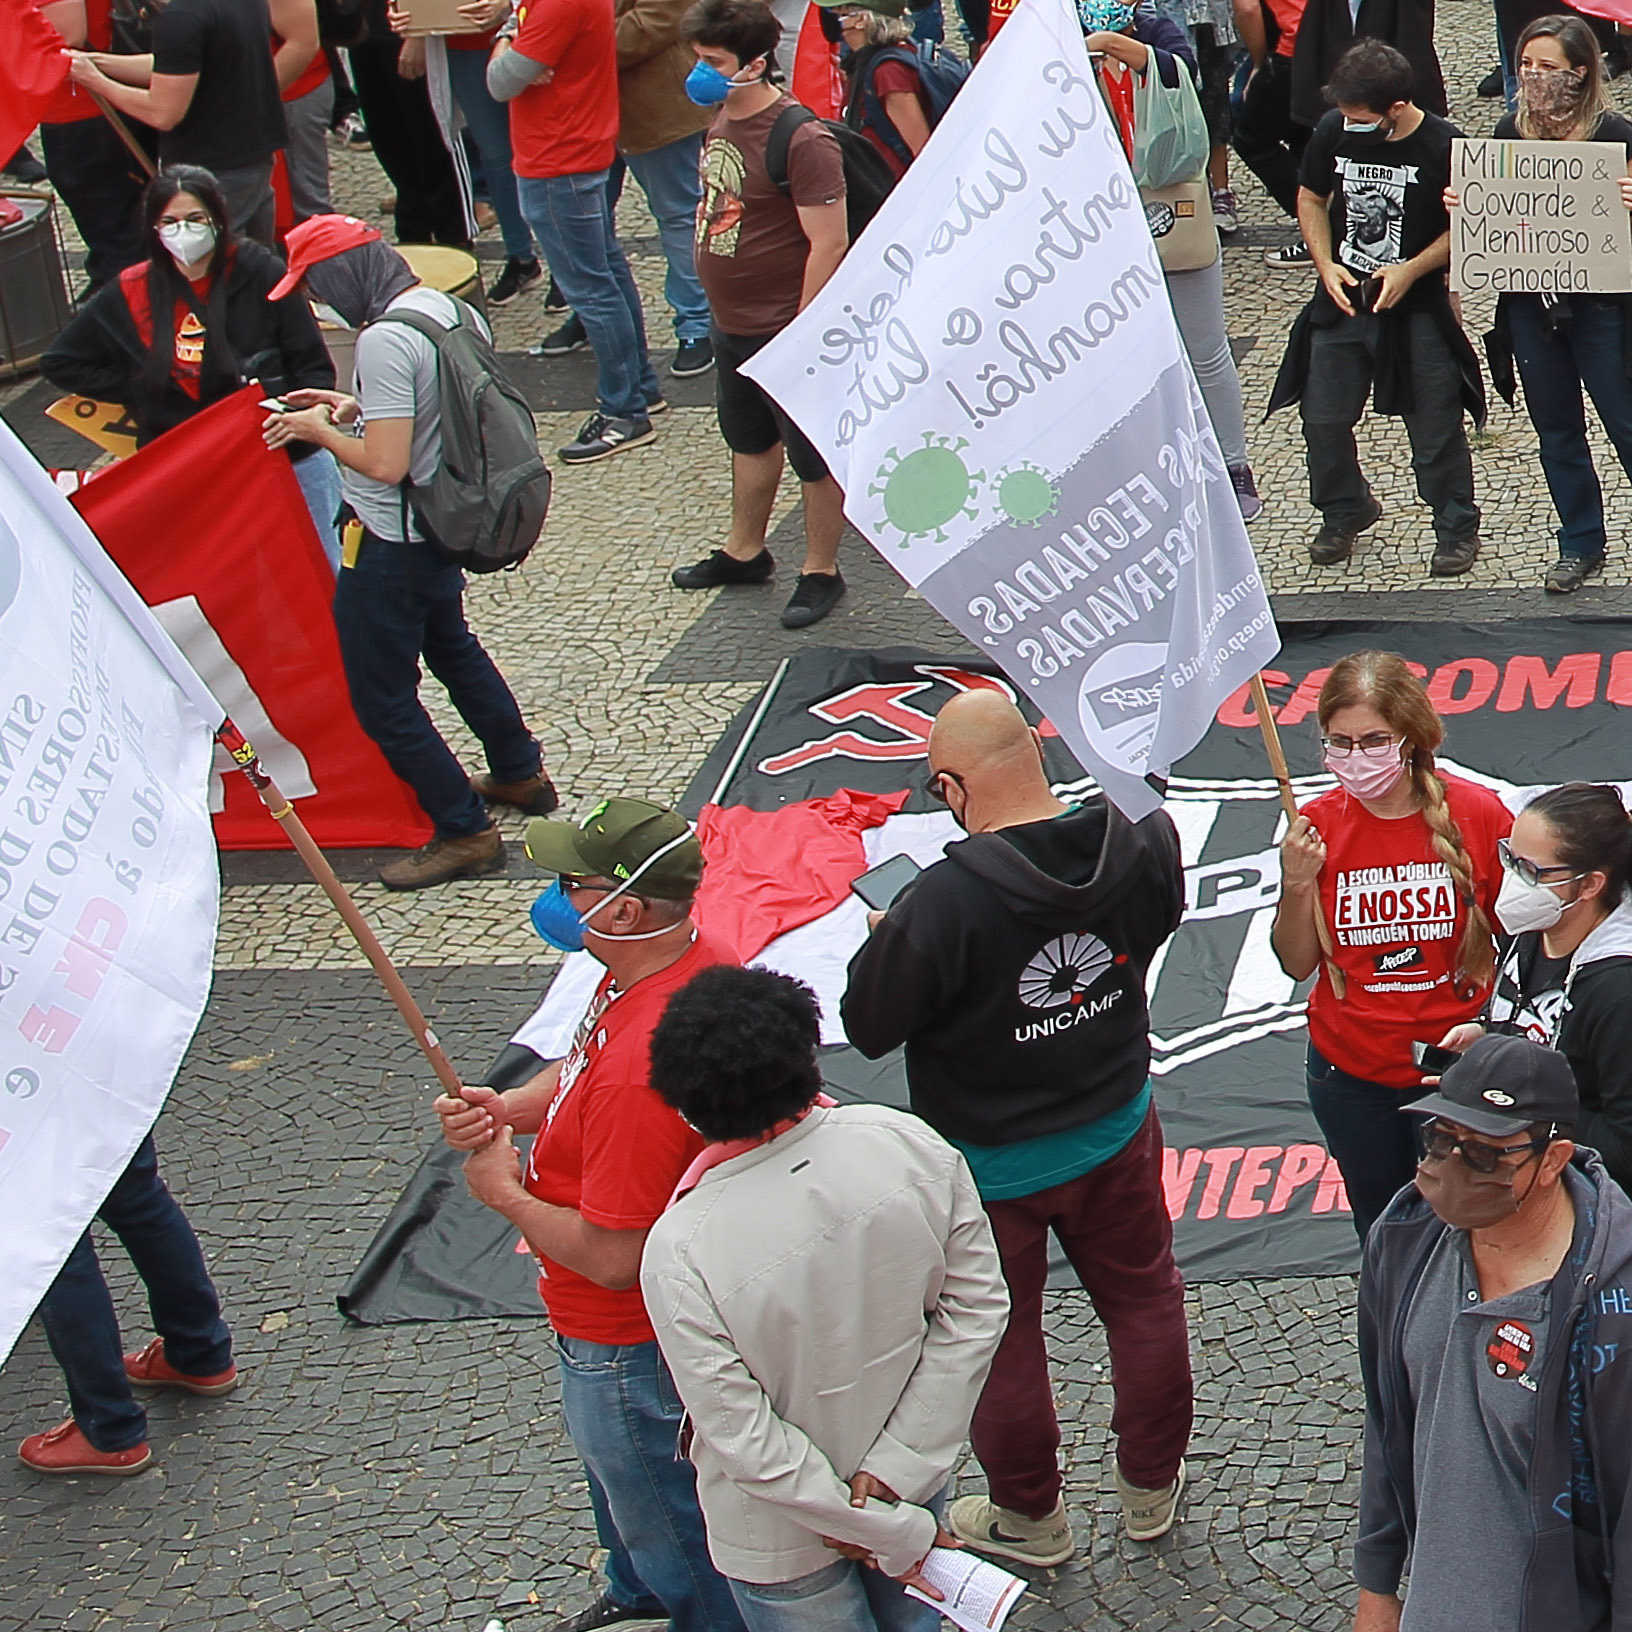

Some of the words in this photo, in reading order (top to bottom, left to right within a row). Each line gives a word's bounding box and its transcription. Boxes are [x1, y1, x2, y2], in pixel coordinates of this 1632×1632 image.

[1357, 163, 1394, 180] NEGRO
[1592, 159, 1610, 180] &
[1461, 181, 1576, 219] Covarde
[1591, 197, 1610, 218] &
[1460, 216, 1590, 256] Mentiroso
[1601, 234, 1620, 255] &
[1336, 872, 1347, 889] A
[1347, 865, 1395, 887] ESCOLA
[1396, 859, 1452, 882] PÚBLICA
[1339, 891, 1355, 924] É
[1357, 886, 1453, 923] NOSSA
[1337, 927, 1347, 946] E
[1347, 920, 1409, 945] NINGUÉM
[1410, 920, 1454, 941] TOMA!
[1013, 987, 1122, 1044] UNICAMP
